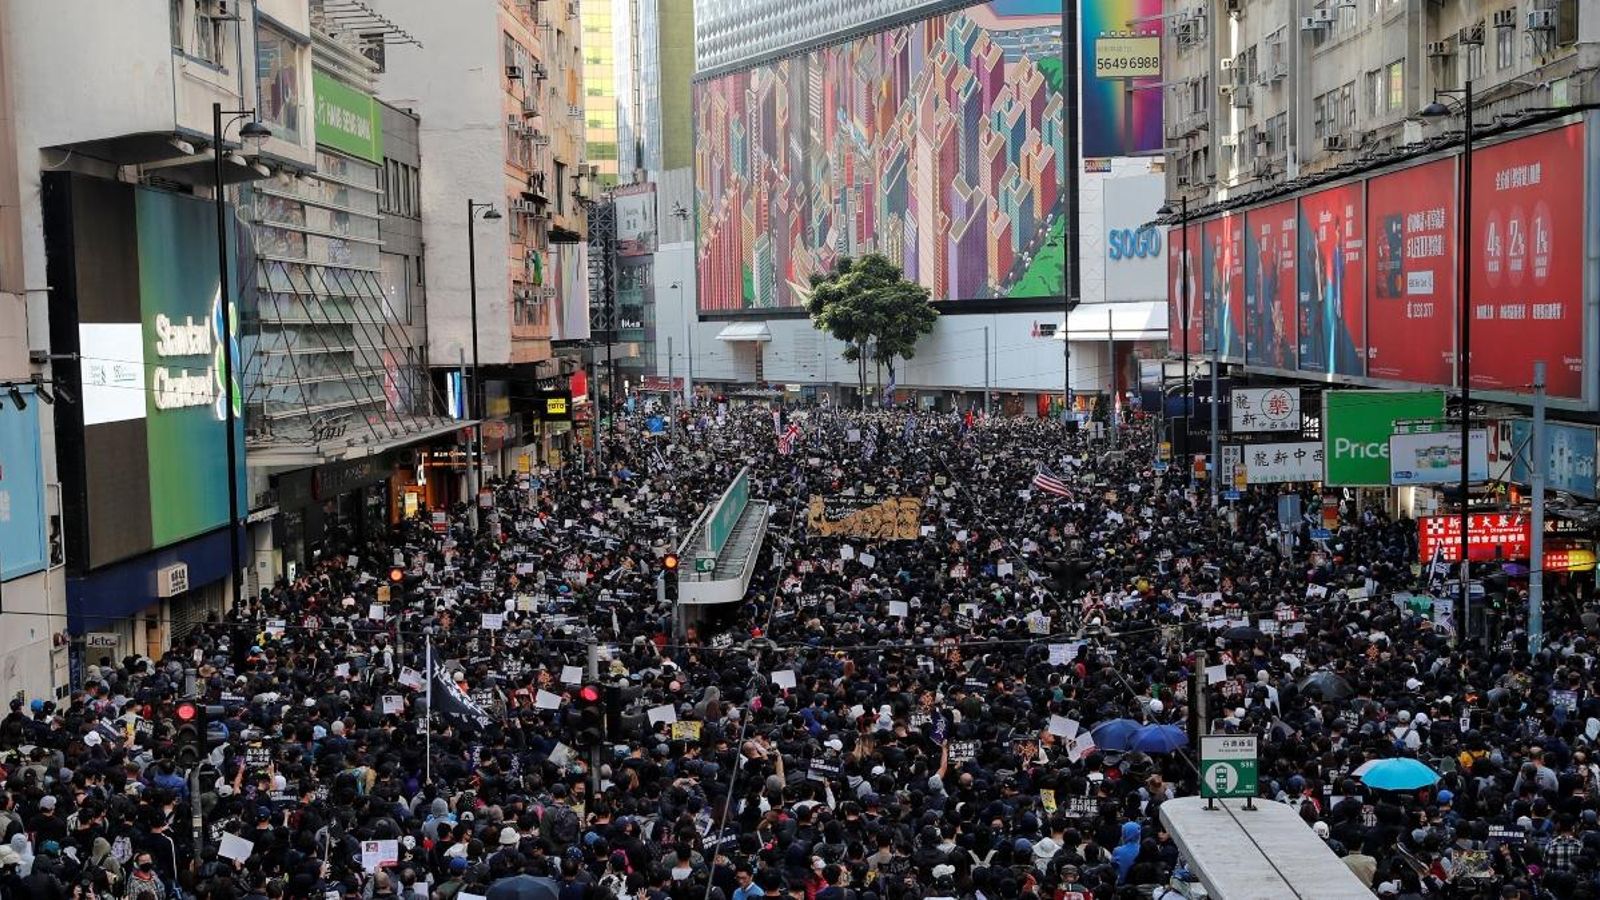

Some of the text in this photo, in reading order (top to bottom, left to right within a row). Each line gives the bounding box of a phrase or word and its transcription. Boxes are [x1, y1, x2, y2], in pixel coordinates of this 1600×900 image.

[1097, 56, 1159, 70] 5649 6988
[1109, 228, 1161, 260] SOGO
[154, 366, 213, 409] Chartered
